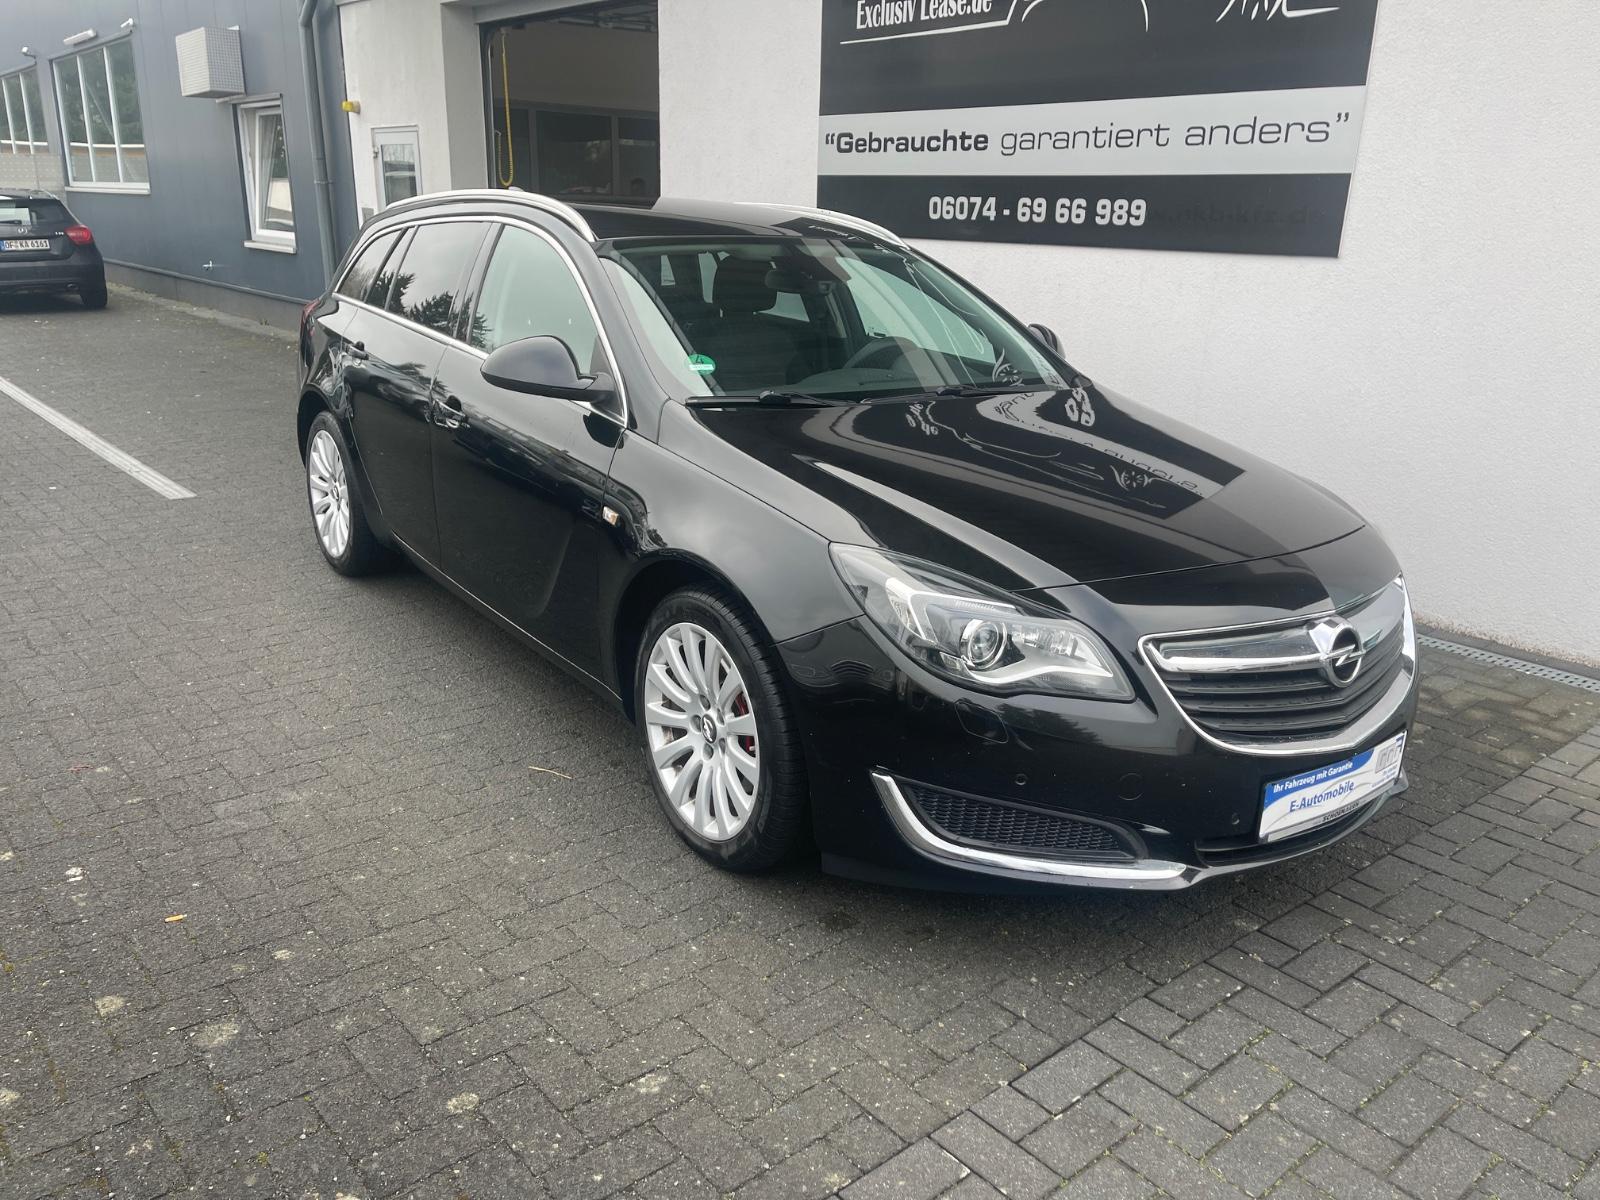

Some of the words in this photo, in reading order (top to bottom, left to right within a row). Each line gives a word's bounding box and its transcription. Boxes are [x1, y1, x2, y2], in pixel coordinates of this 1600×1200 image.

[856, 0, 917, 29] Exclusiv
[920, 0, 992, 21] Lease.de
[1000, 122, 1170, 156] garantiert
[928, 195, 996, 221] 06074
[1016, 198, 1046, 223] 69
[1055, 198, 1086, 224] 66
[1095, 198, 1147, 226] 989
[1273, 784, 1284, 793] Ihr
[1284, 775, 1316, 791] Fahrzeug
[1316, 770, 1328, 780] mit
[1328, 761, 1354, 776] Garantie
[1289, 780, 1355, 813] E-Automobile
